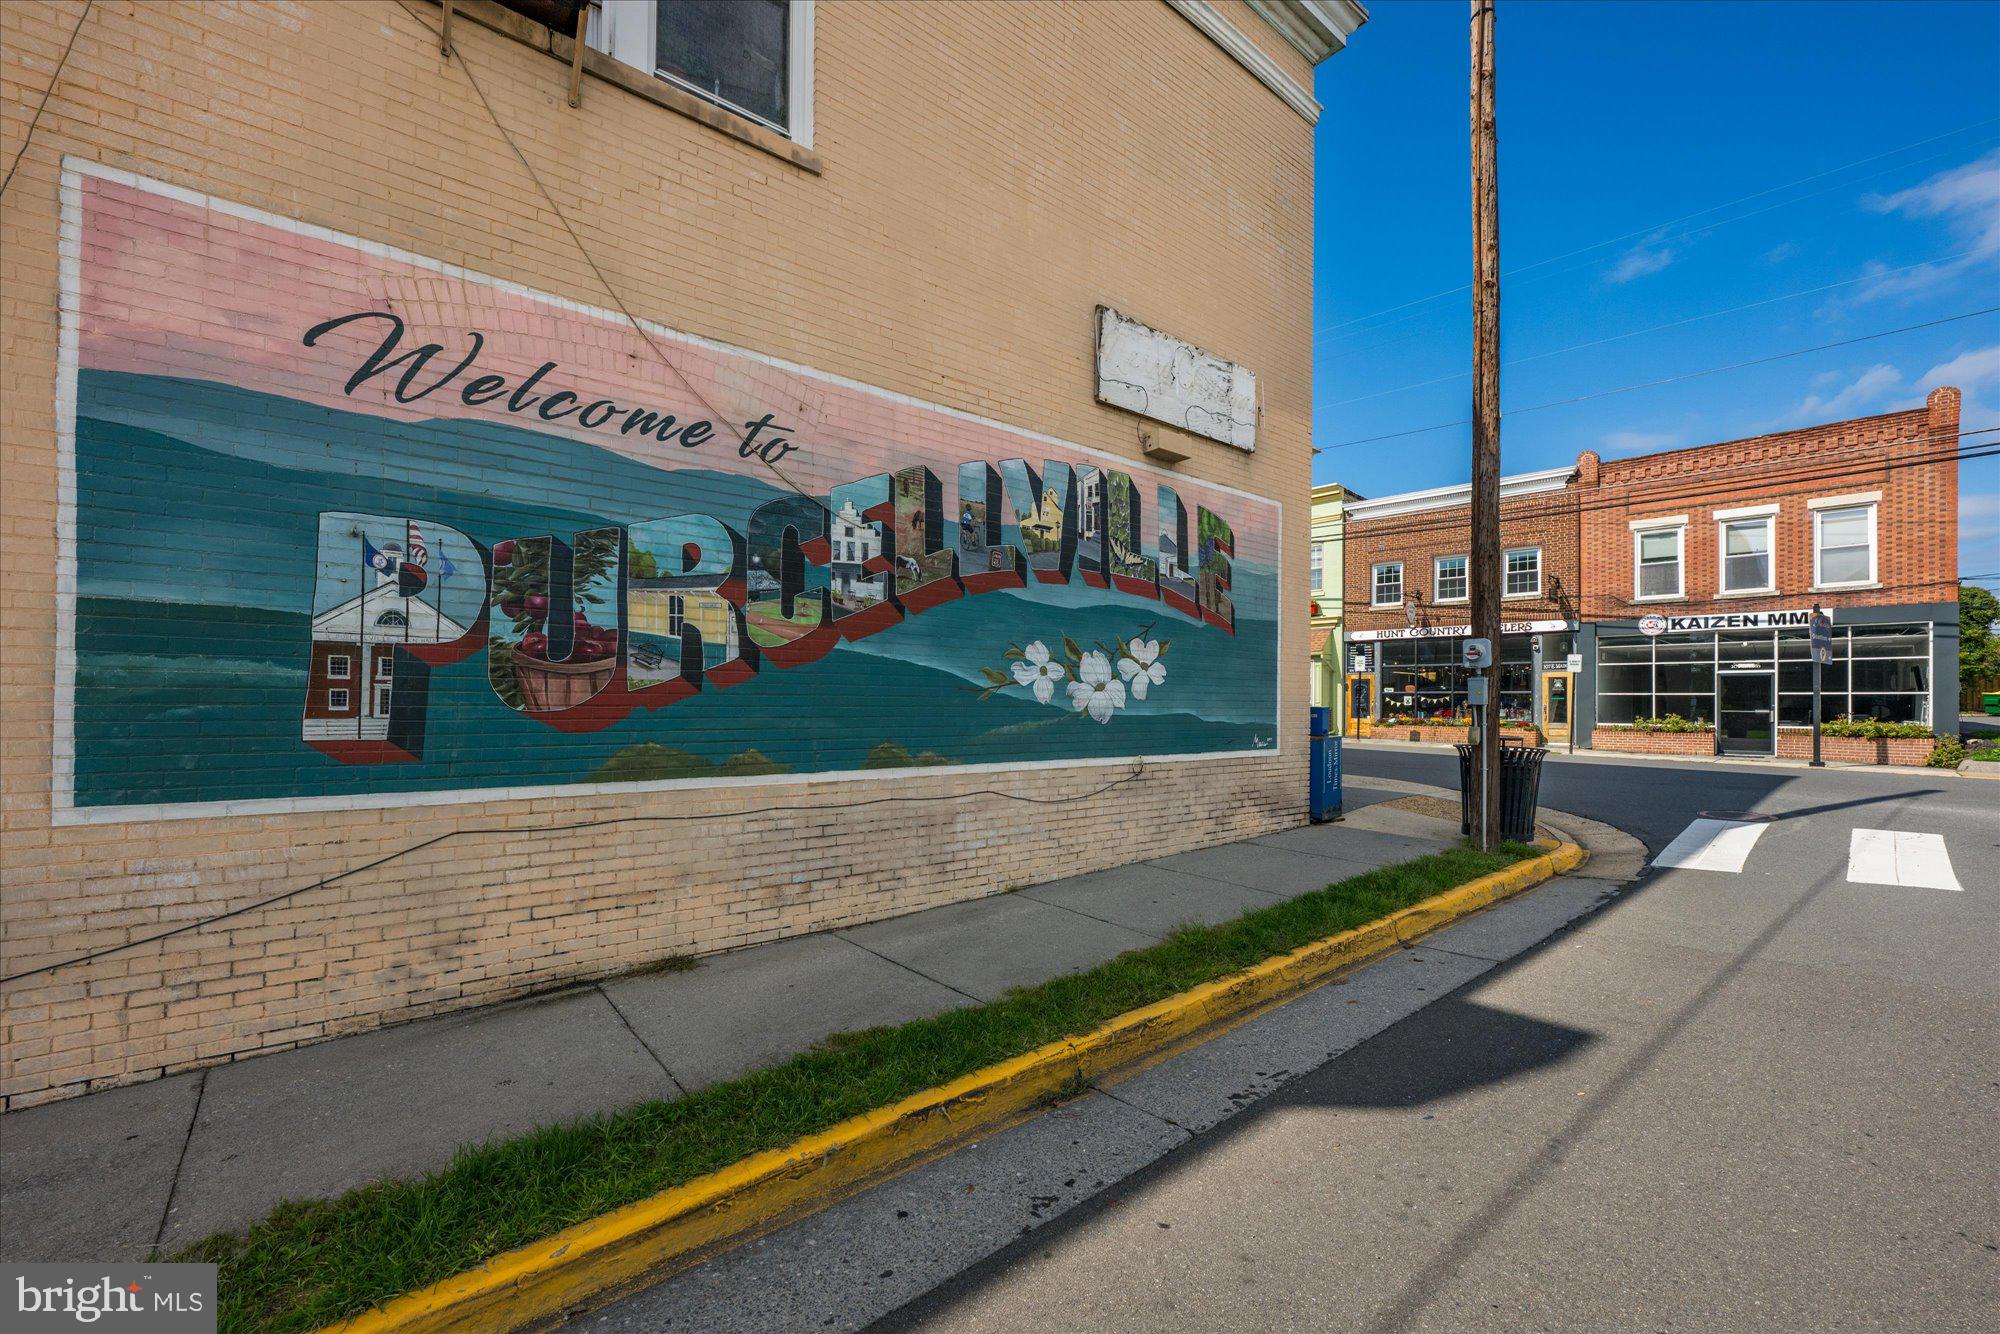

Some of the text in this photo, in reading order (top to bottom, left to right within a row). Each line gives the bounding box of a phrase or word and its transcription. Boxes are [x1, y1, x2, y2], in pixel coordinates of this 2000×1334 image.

[302, 311, 800, 464] Welcome to
[302, 457, 1236, 764] PURCELLVILLE
[1376, 630, 1406, 640] HUNT
[1409, 625, 1468, 638] COUNTRY
[1670, 614, 1759, 630] KAIZEN
[1767, 611, 1809, 626] MM
